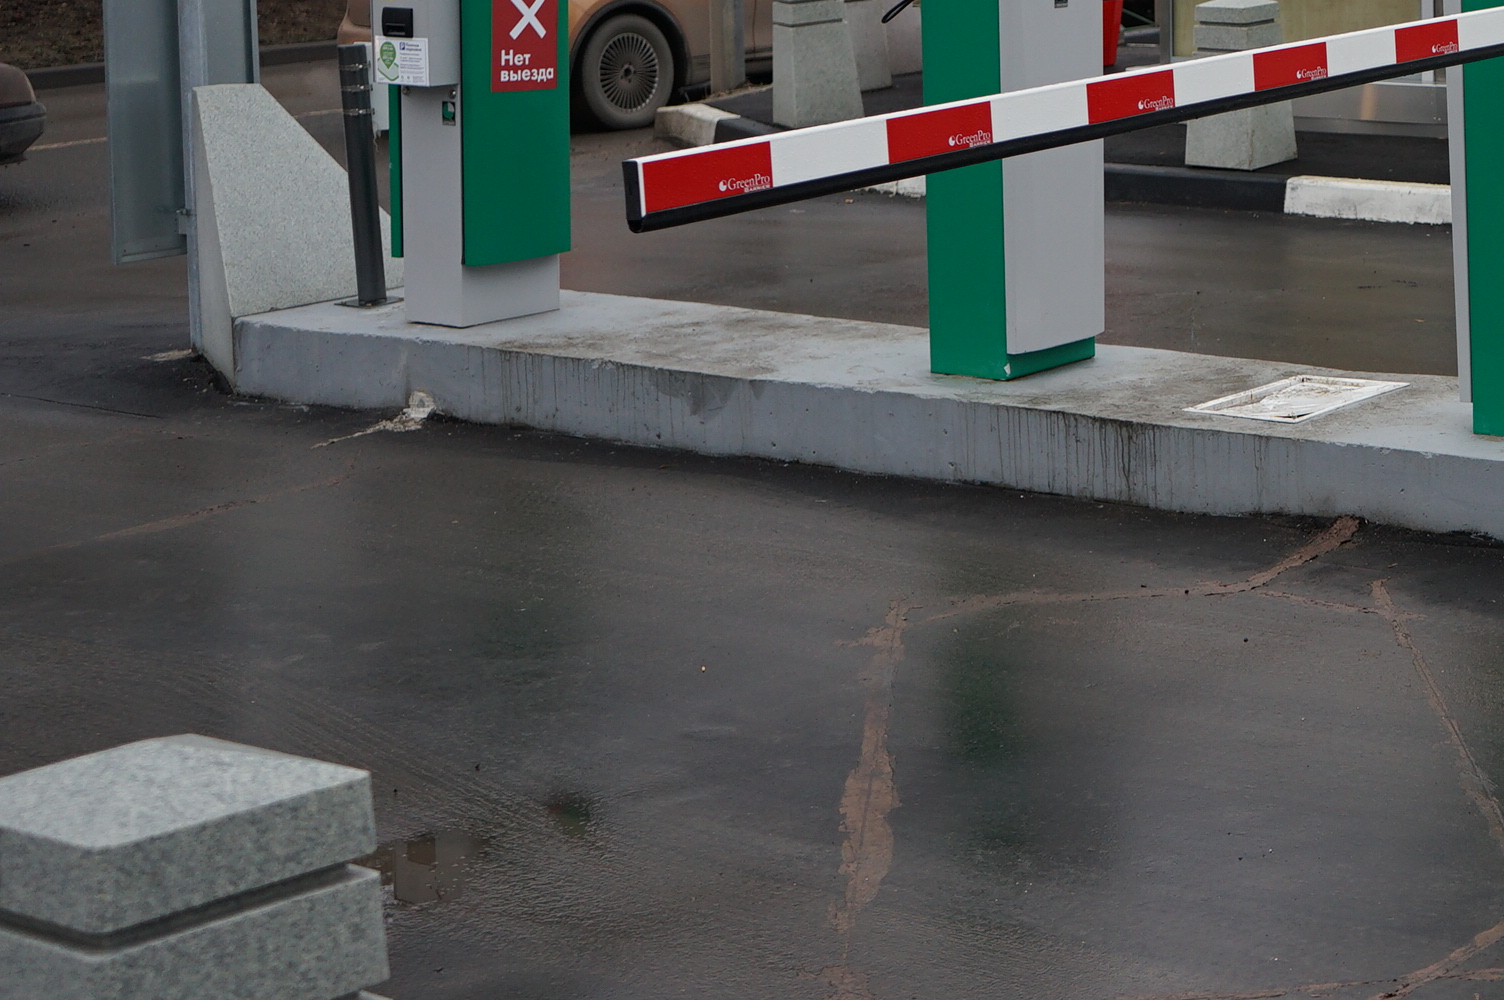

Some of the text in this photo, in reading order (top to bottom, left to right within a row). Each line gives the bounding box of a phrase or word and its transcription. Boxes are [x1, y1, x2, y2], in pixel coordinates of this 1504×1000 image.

[500, 49, 531, 67] Нет
[500, 67, 554, 83] выезда
[955, 129, 991, 145] GreenPro
[727, 173, 770, 190] GreenPro
